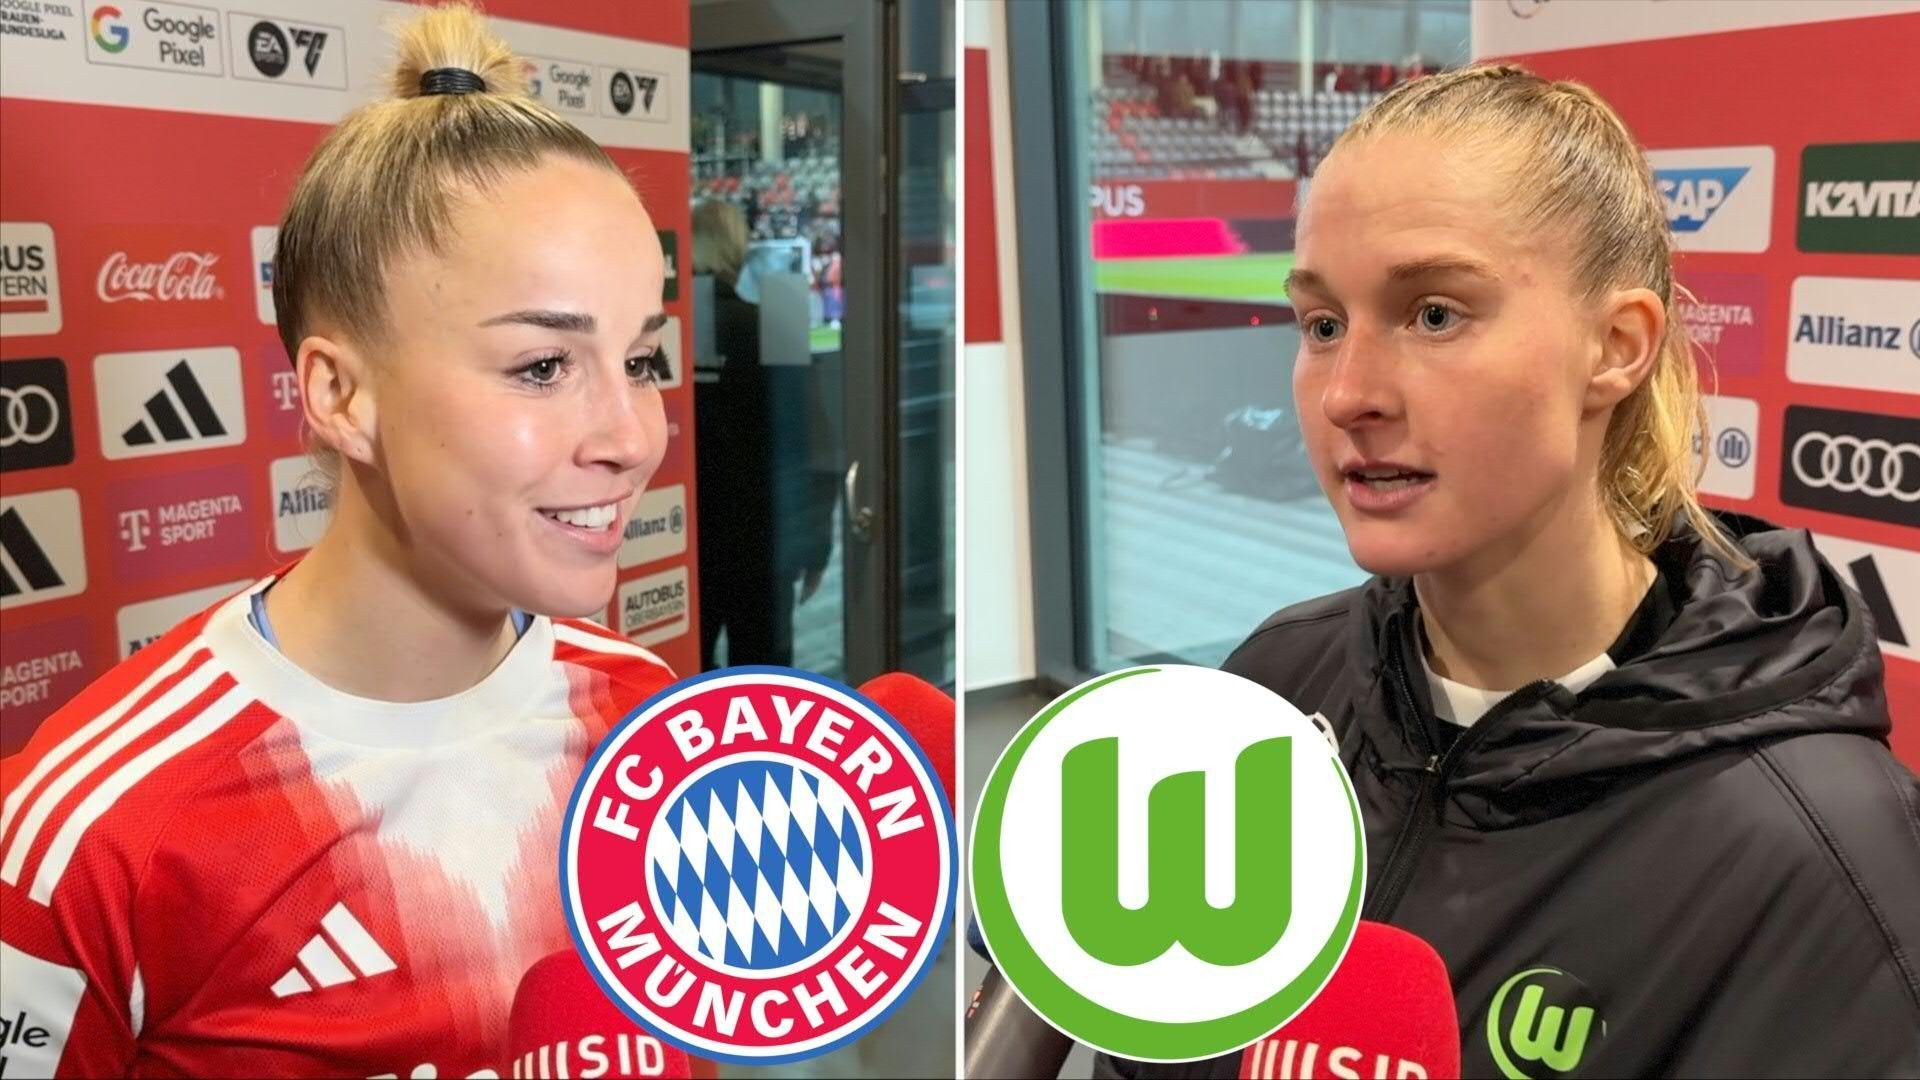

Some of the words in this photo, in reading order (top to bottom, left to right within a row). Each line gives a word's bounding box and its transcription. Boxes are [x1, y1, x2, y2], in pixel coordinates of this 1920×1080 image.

[0, 0, 41, 12] OOGLE
[44, 3, 74, 17] PIXEL
[143, 7, 215, 43] Google
[159, 41, 205, 67] Pixel
[550, 64, 591, 92] Google
[559, 89, 586, 109] Pixel
[0, 245, 45, 271] US
[0, 275, 48, 297] ERN
[97, 251, 220, 302] Coca-Cola
[1795, 313, 1901, 350] Allianz
[158, 495, 242, 525] MAGENTA
[279, 485, 331, 517] Allia
[161, 519, 216, 547] SPORT
[625, 580, 685, 612] AUTOBUS
[0, 650, 83, 688] AGENTA
[0, 679, 51, 711] PORT
[578, 1034, 665, 1079] SID
